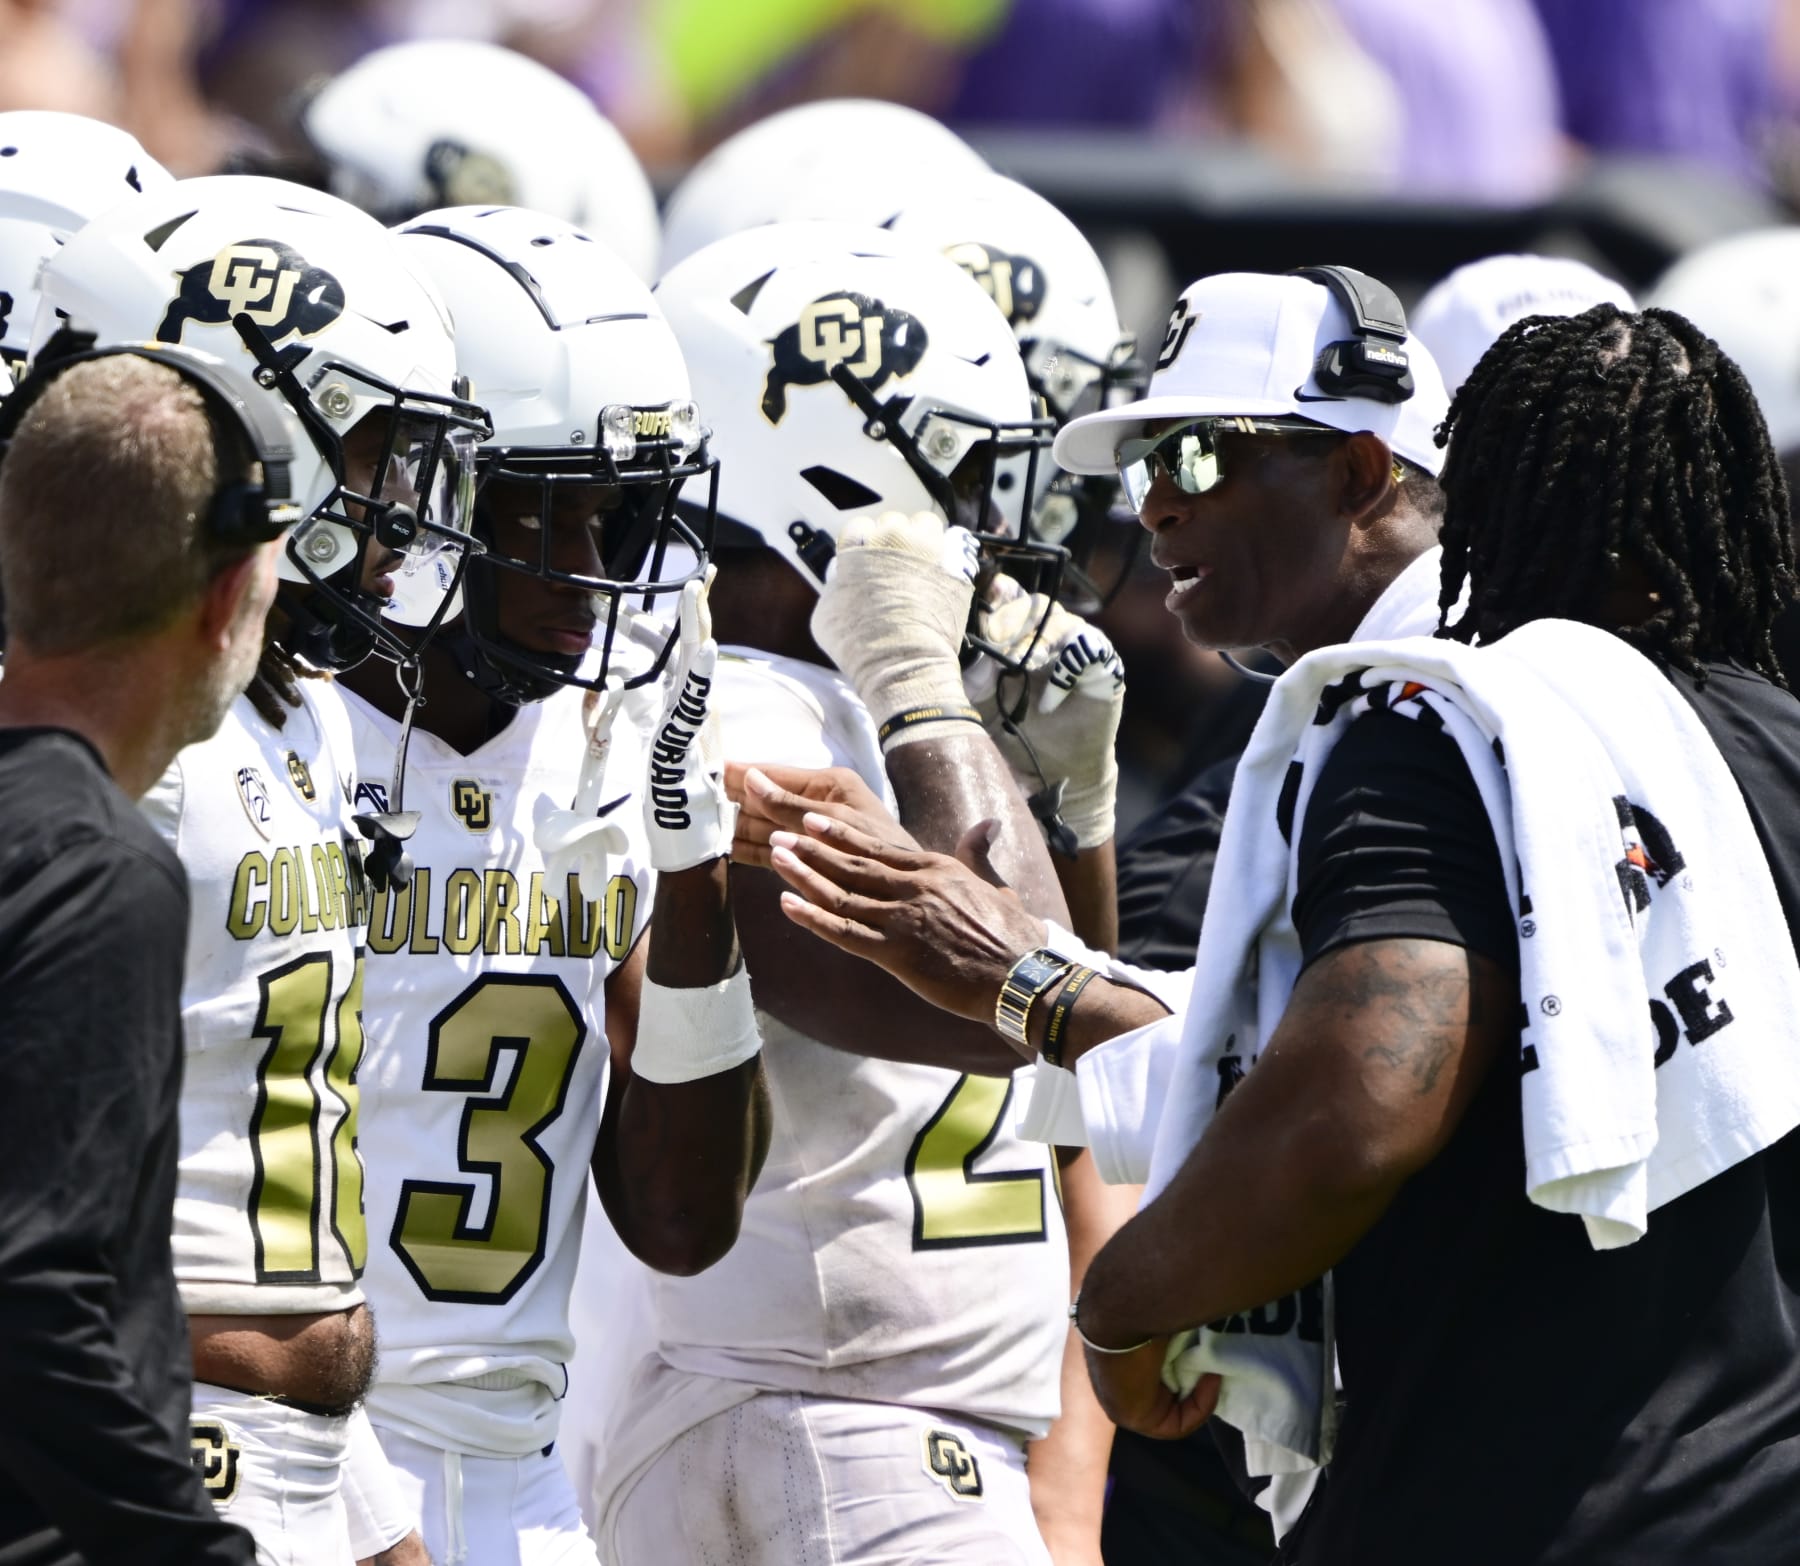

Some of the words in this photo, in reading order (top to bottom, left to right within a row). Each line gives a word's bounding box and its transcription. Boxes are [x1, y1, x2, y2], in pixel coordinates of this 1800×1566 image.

[453, 779, 492, 830] CU
[650, 669, 711, 830] COLORADO
[388, 971, 588, 1306] 3
